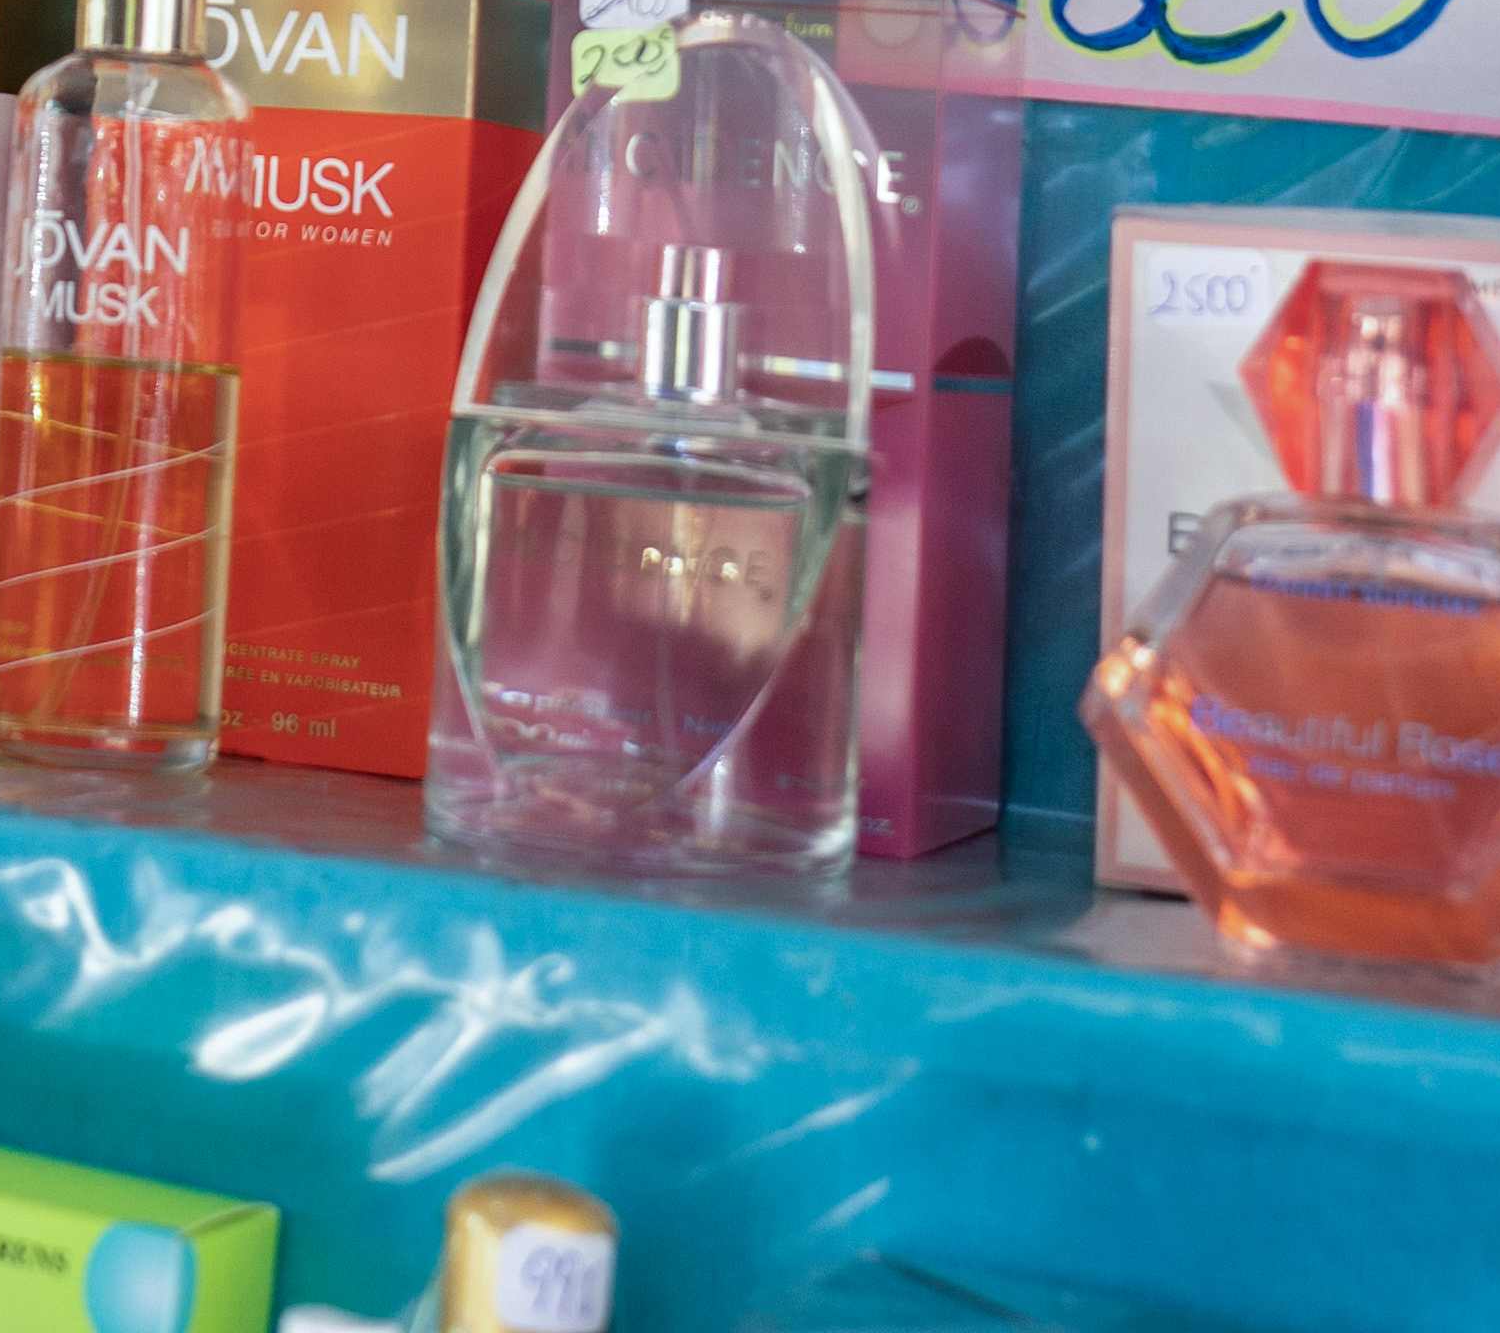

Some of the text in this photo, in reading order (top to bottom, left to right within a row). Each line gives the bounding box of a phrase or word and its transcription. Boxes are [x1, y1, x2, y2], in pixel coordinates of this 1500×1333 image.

[251, 219, 394, 247] OR WOMEN
[30, 280, 161, 327] MUSK
